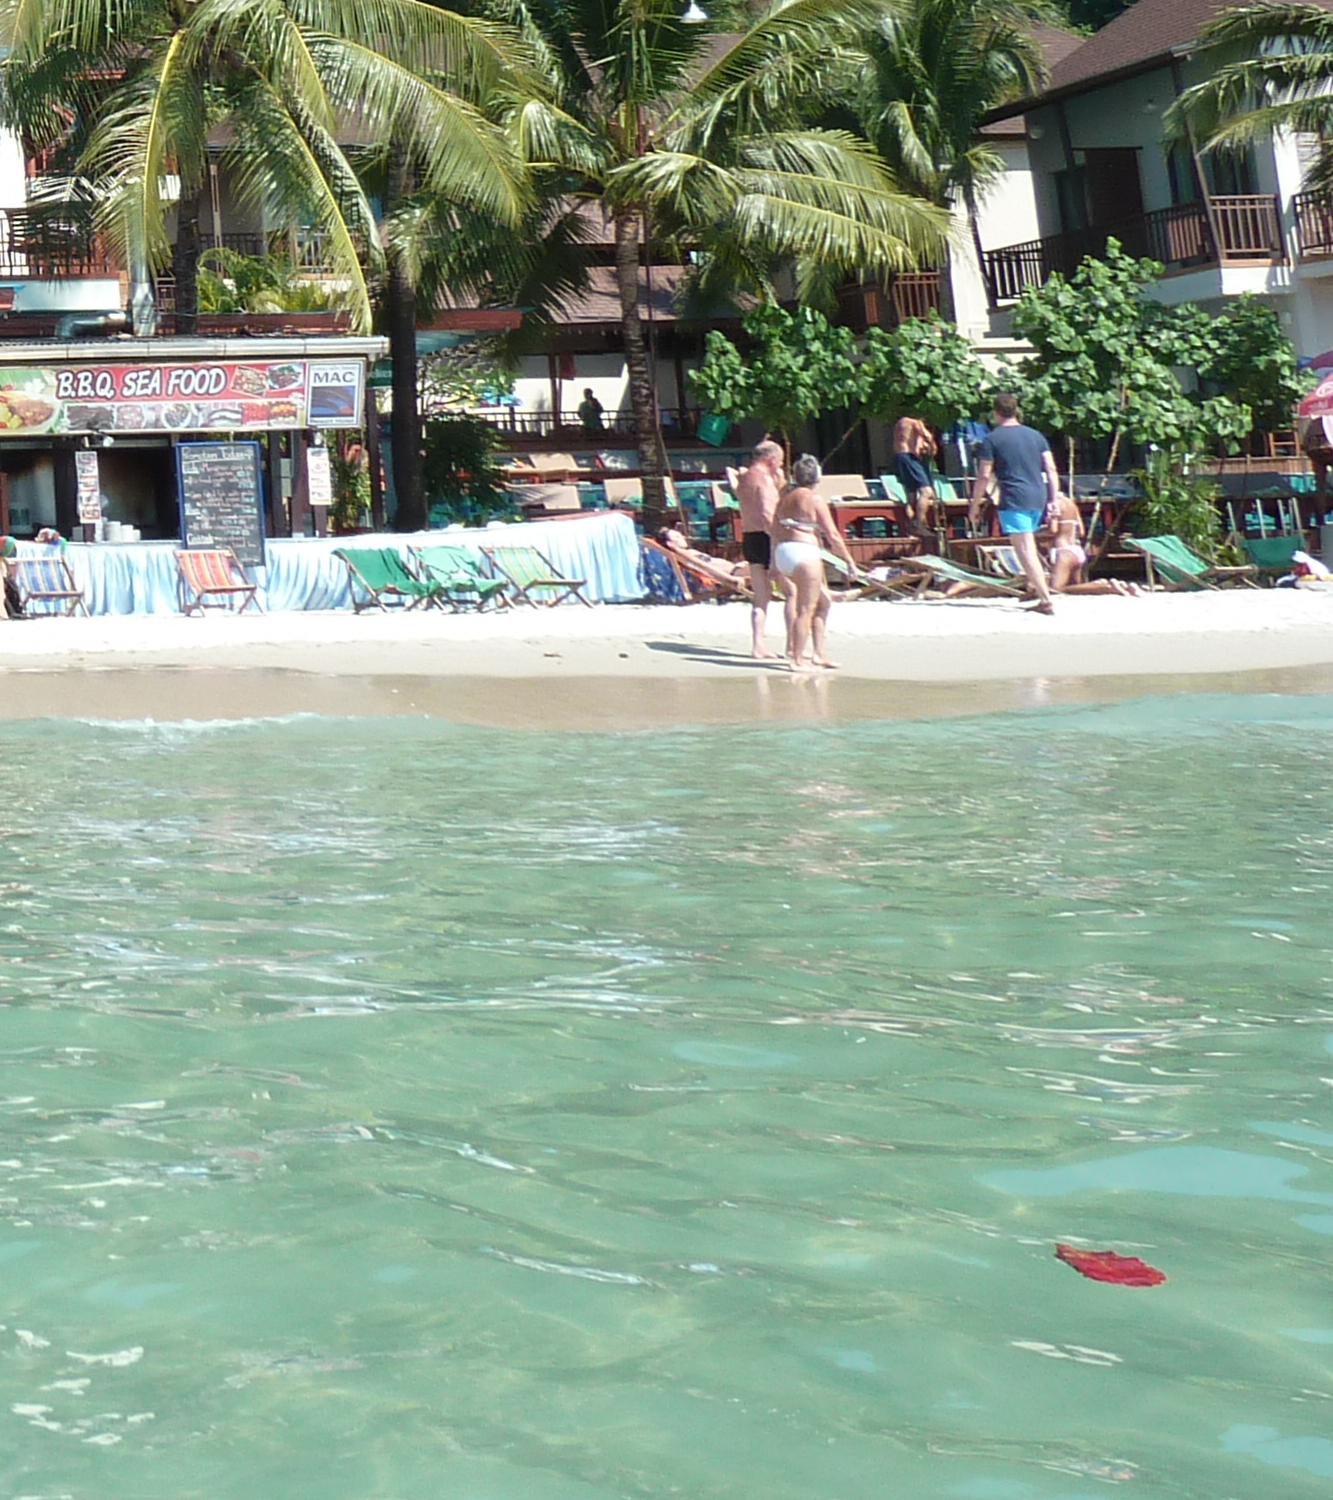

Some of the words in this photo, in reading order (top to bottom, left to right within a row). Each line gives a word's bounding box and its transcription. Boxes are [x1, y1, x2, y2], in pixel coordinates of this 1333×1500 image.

[122, 369, 161, 397] SEA
[167, 367, 226, 395] FOOD
[313, 371, 354, 383] MAC
